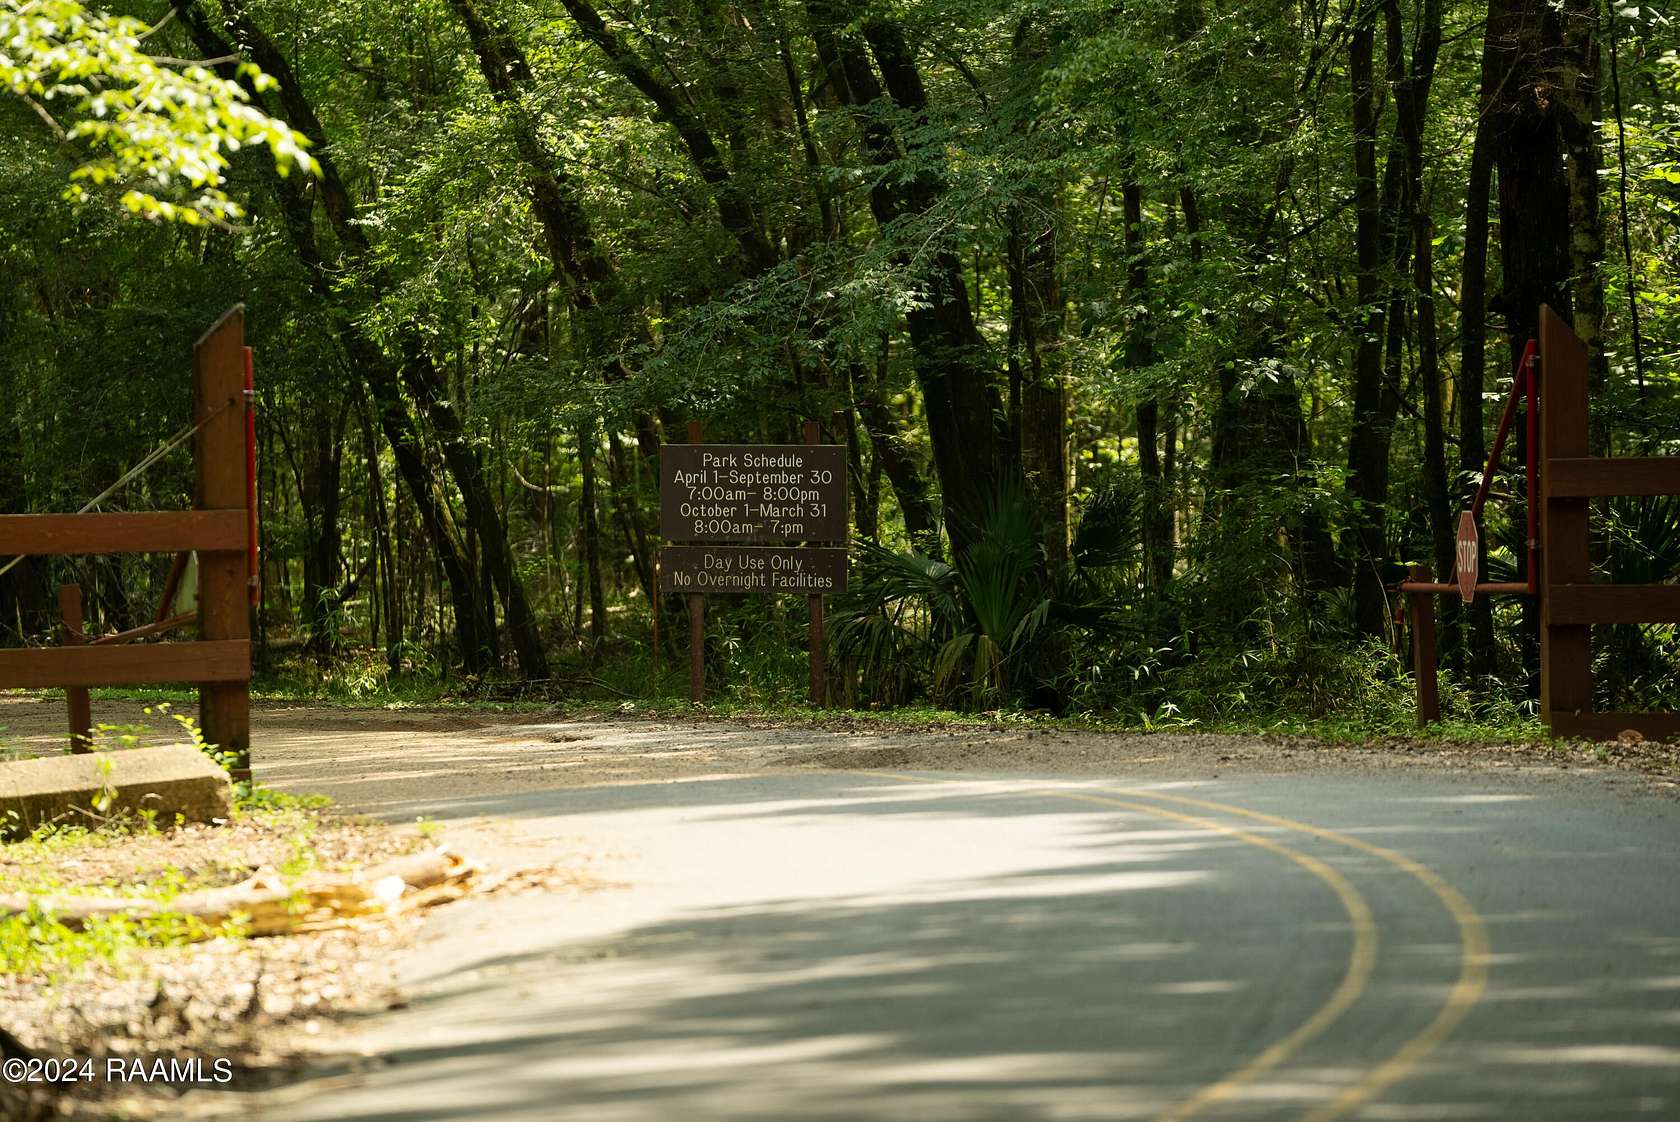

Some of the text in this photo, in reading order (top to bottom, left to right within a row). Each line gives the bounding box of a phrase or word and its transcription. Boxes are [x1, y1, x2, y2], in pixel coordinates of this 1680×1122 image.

[703, 453, 803, 468] Park Schedule
[674, 470, 707, 487] April
[810, 470, 832, 485] 30
[763, 487, 820, 503] 8:00pm
[680, 503, 737, 517] October
[810, 503, 827, 517] 31
[770, 520, 804, 536] 7:pm
[704, 554, 803, 572] Day Use Only
[1458, 540, 1477, 573] STOP
[674, 571, 833, 589] No Overnight Facilities
